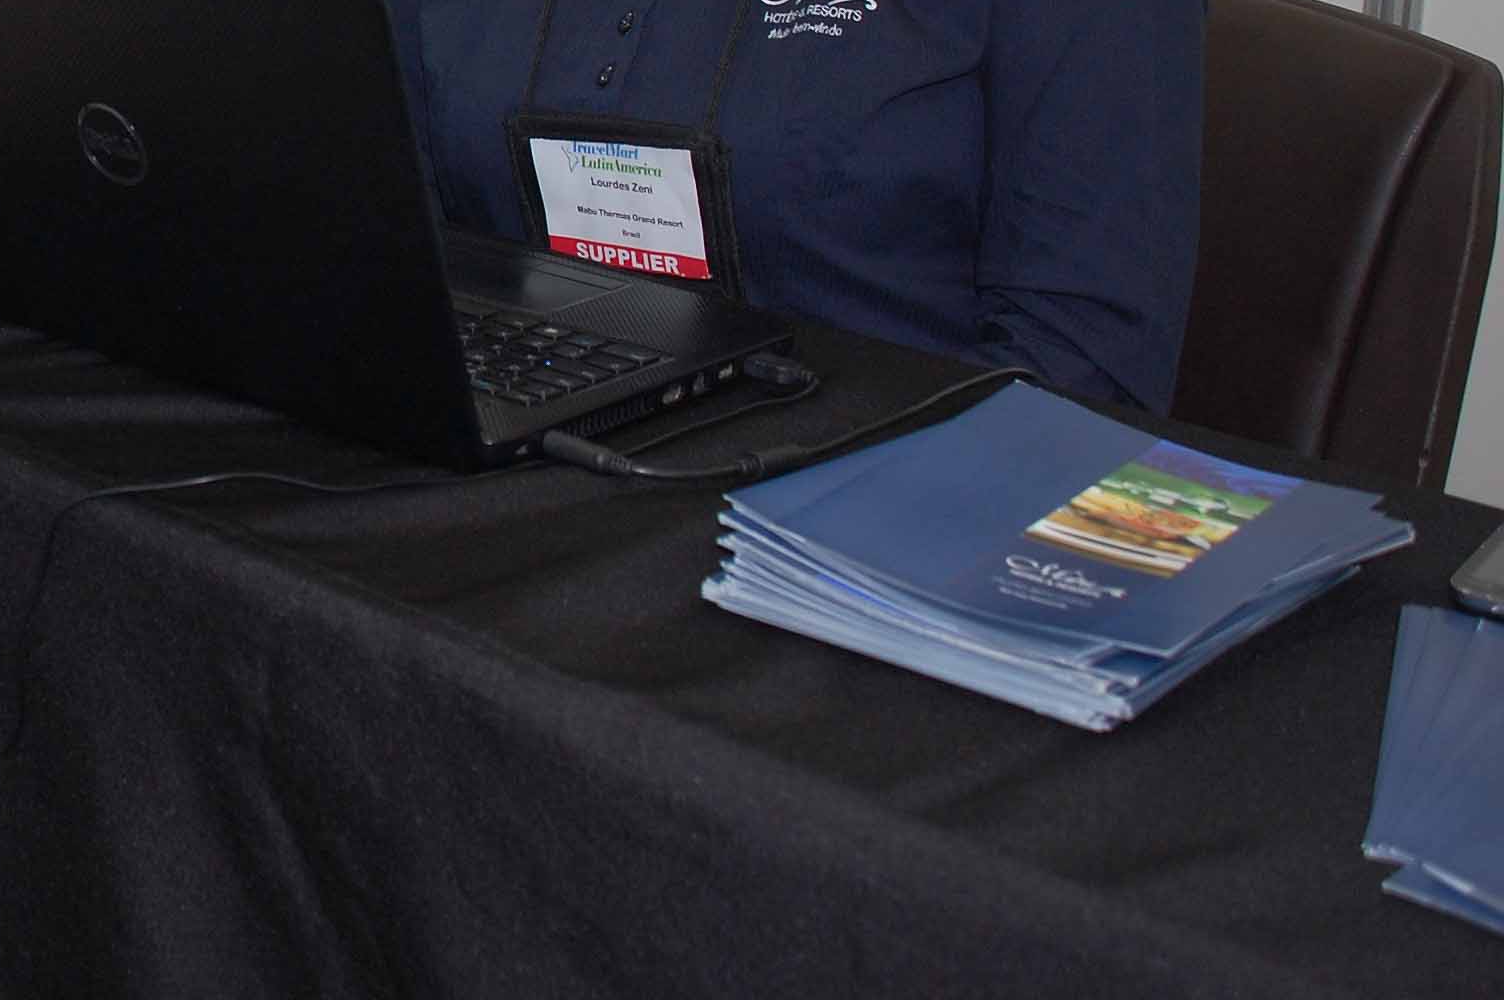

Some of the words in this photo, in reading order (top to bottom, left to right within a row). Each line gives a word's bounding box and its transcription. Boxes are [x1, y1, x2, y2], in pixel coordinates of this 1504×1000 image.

[806, 4, 863, 22] RESORTS
[573, 140, 639, 160] TravelMart
[581, 155, 663, 178] LatinAmerica
[590, 176, 631, 193] Lourdes
[632, 182, 654, 195] Zeni
[576, 241, 681, 275] SUPPLIER
